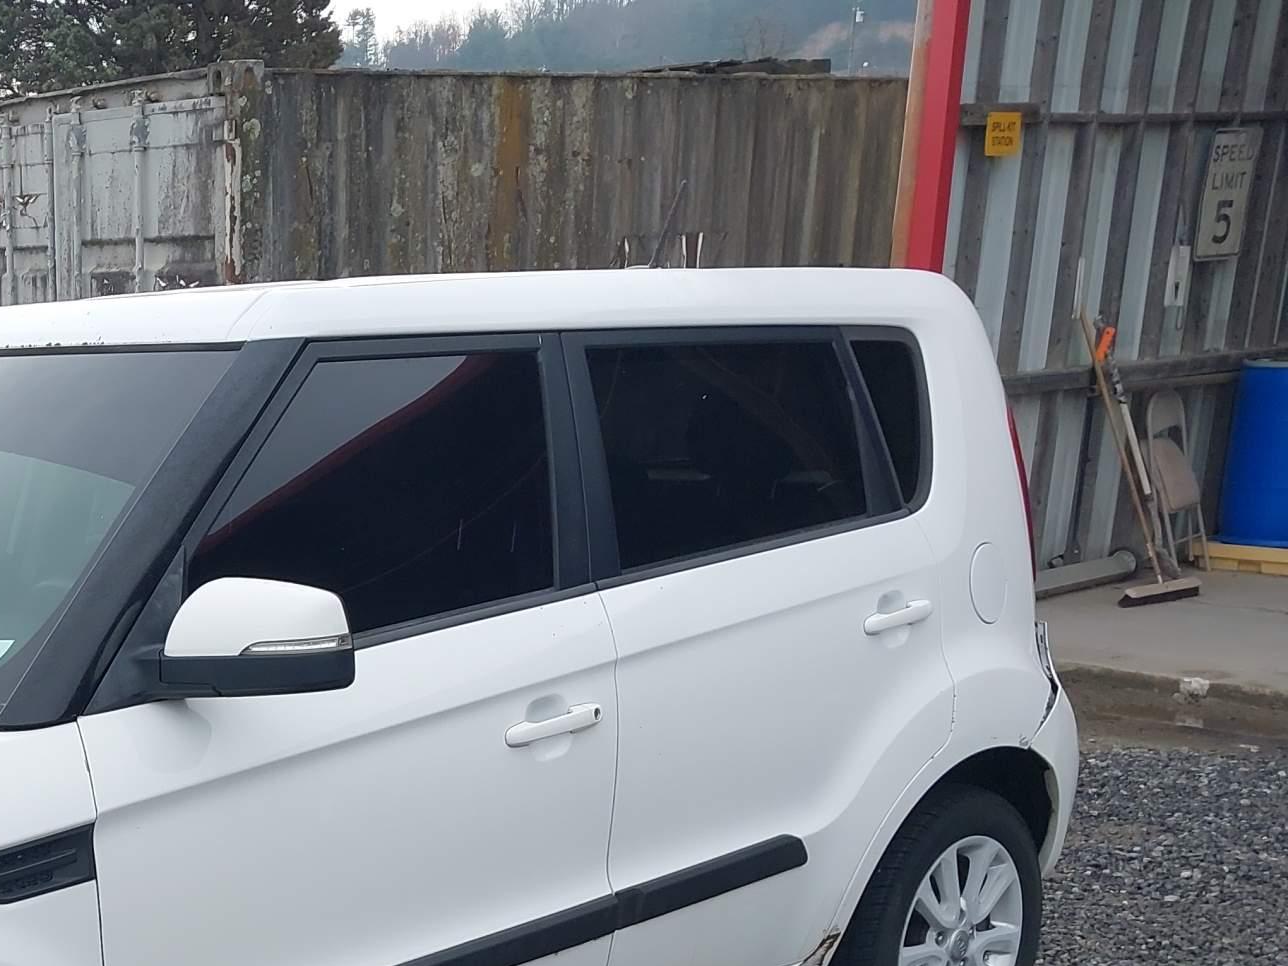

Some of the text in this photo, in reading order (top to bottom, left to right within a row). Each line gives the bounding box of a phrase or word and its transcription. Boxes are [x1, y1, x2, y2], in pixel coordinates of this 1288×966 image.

[1213, 143, 1254, 163] SPEED
[1211, 171, 1247, 191] LIMIT
[1211, 199, 1234, 245] 5
